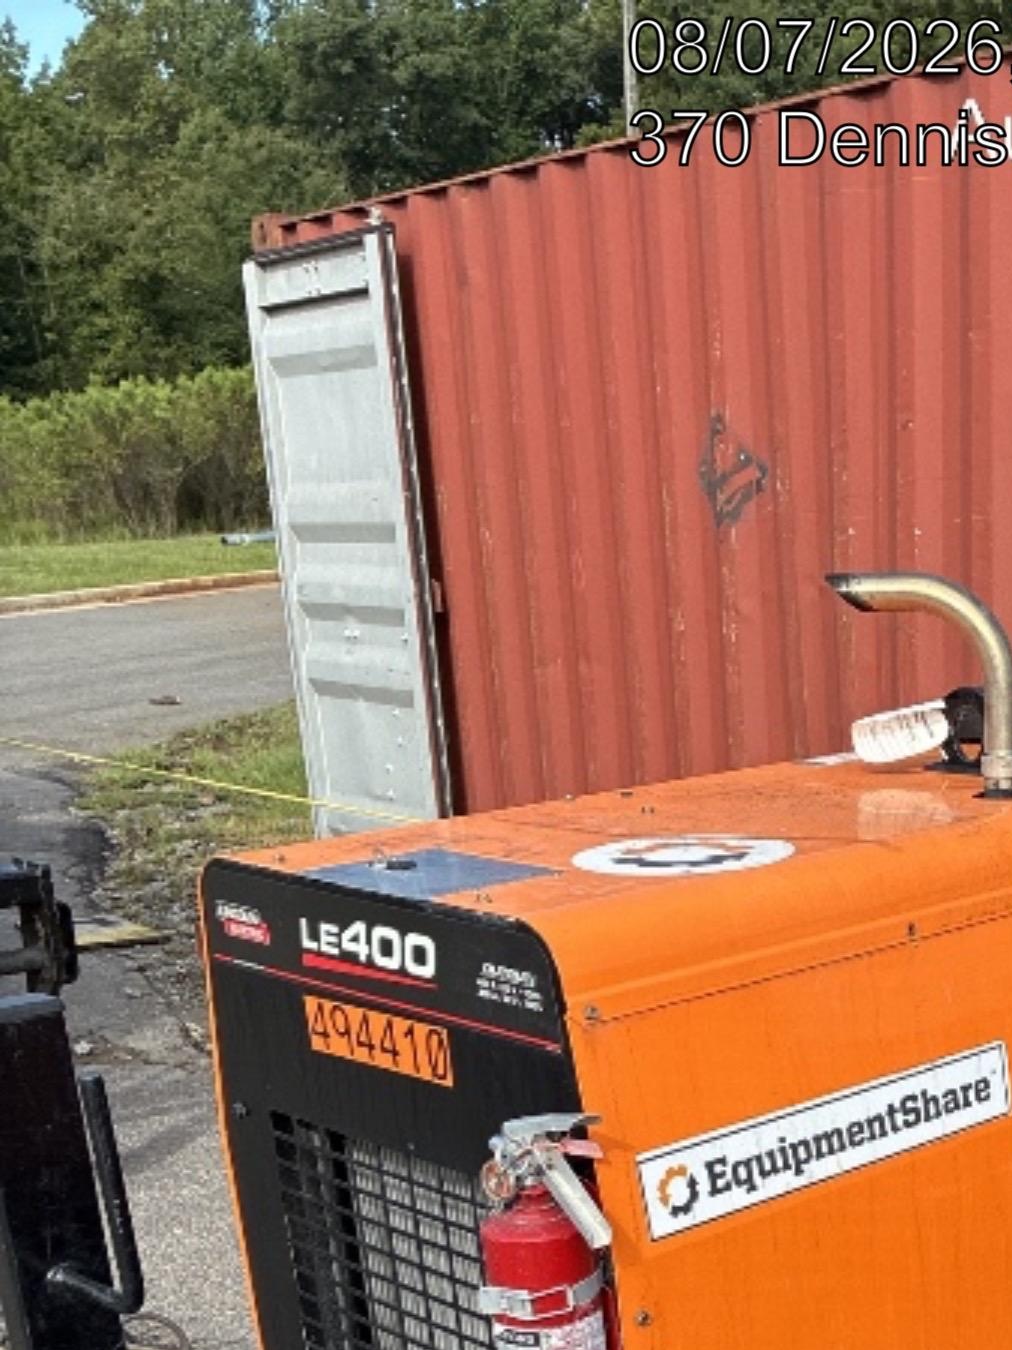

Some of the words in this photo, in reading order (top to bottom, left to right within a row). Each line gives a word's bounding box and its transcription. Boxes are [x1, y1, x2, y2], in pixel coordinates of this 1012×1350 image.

[300, 917, 436, 979] LE400
[311, 1001, 449, 1082] 494410
[704, 1076, 991, 1198] EquipmentShare
